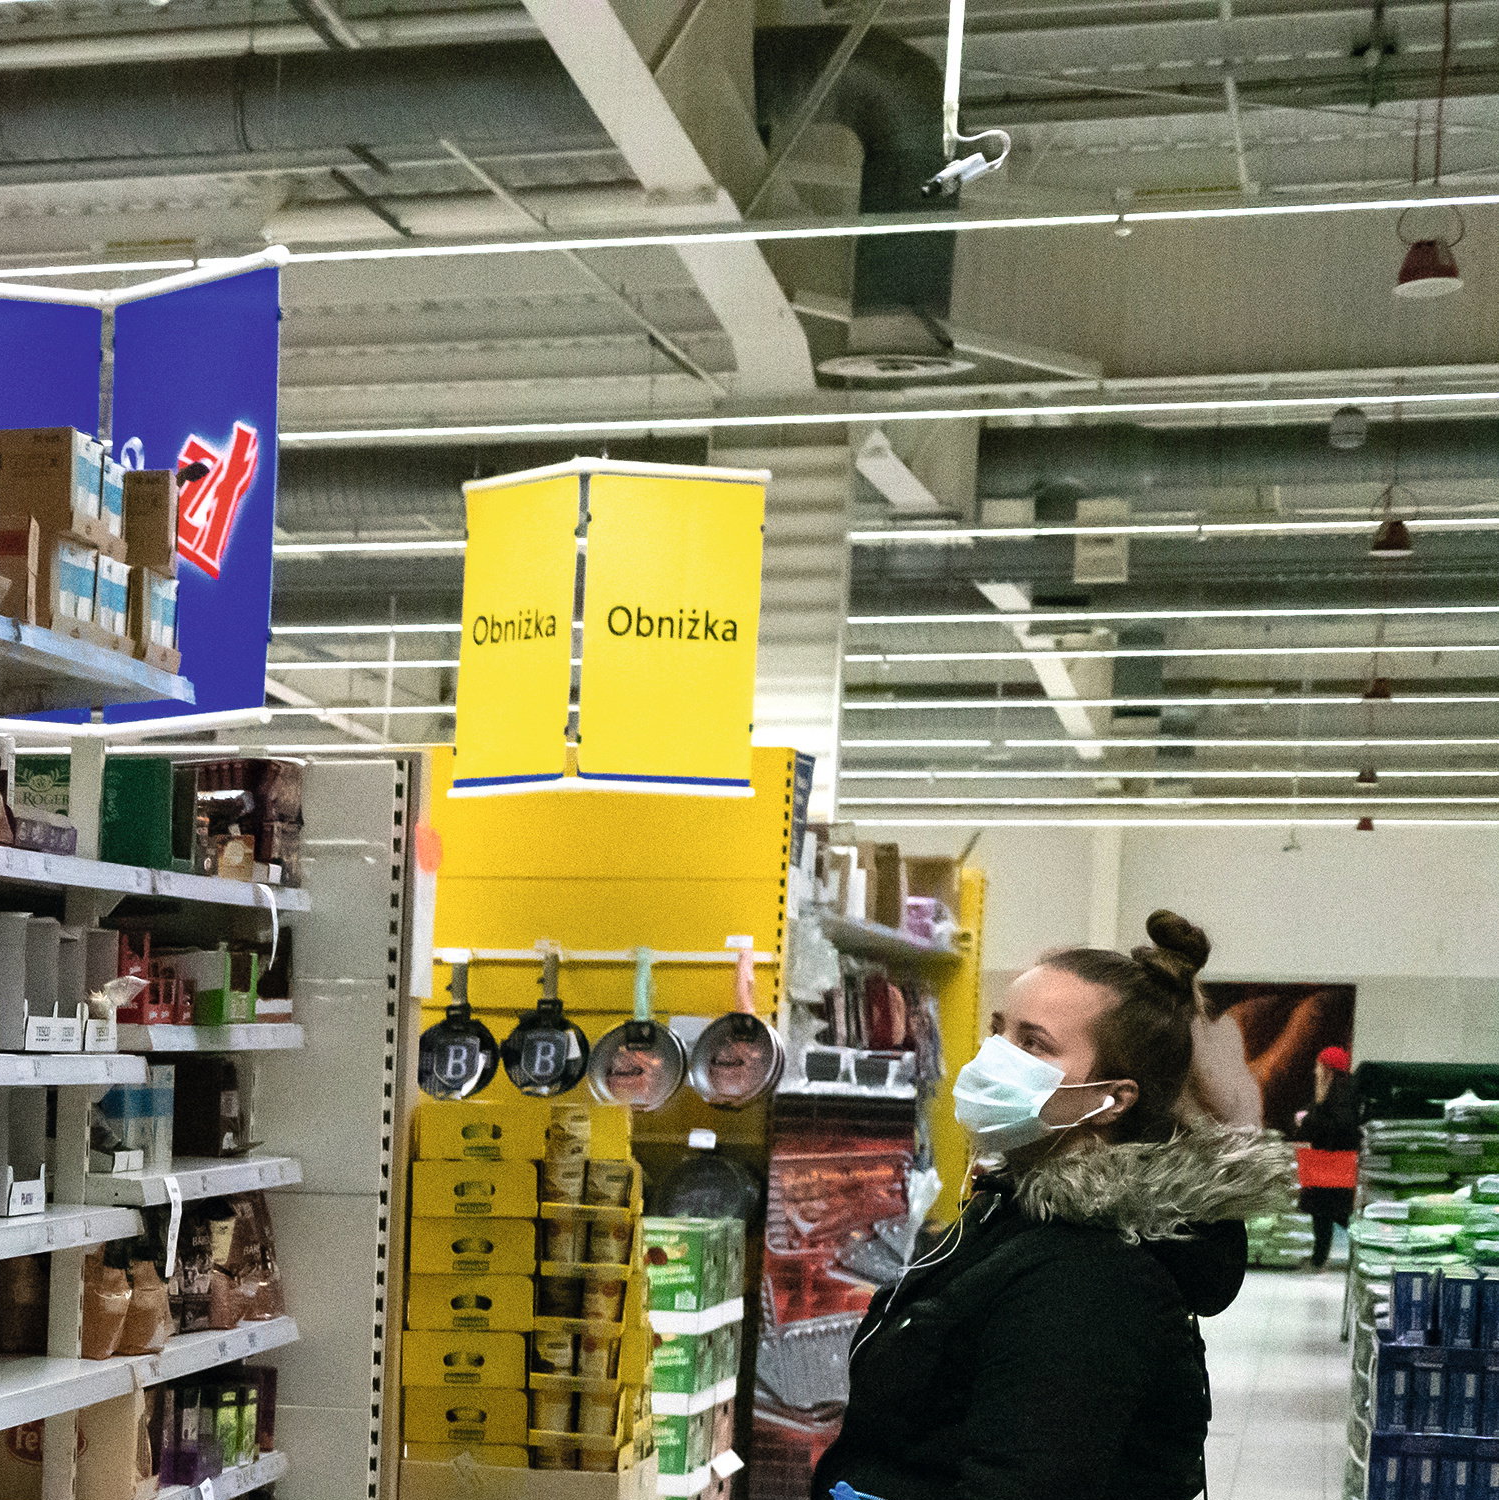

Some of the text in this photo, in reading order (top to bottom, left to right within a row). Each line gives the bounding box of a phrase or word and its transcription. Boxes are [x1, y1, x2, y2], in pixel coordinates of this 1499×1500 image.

[471, 610, 558, 646] Obniżka
[606, 604, 740, 644] Obniżka
[448, 1044, 469, 1078] B
[533, 1040, 556, 1076] B
